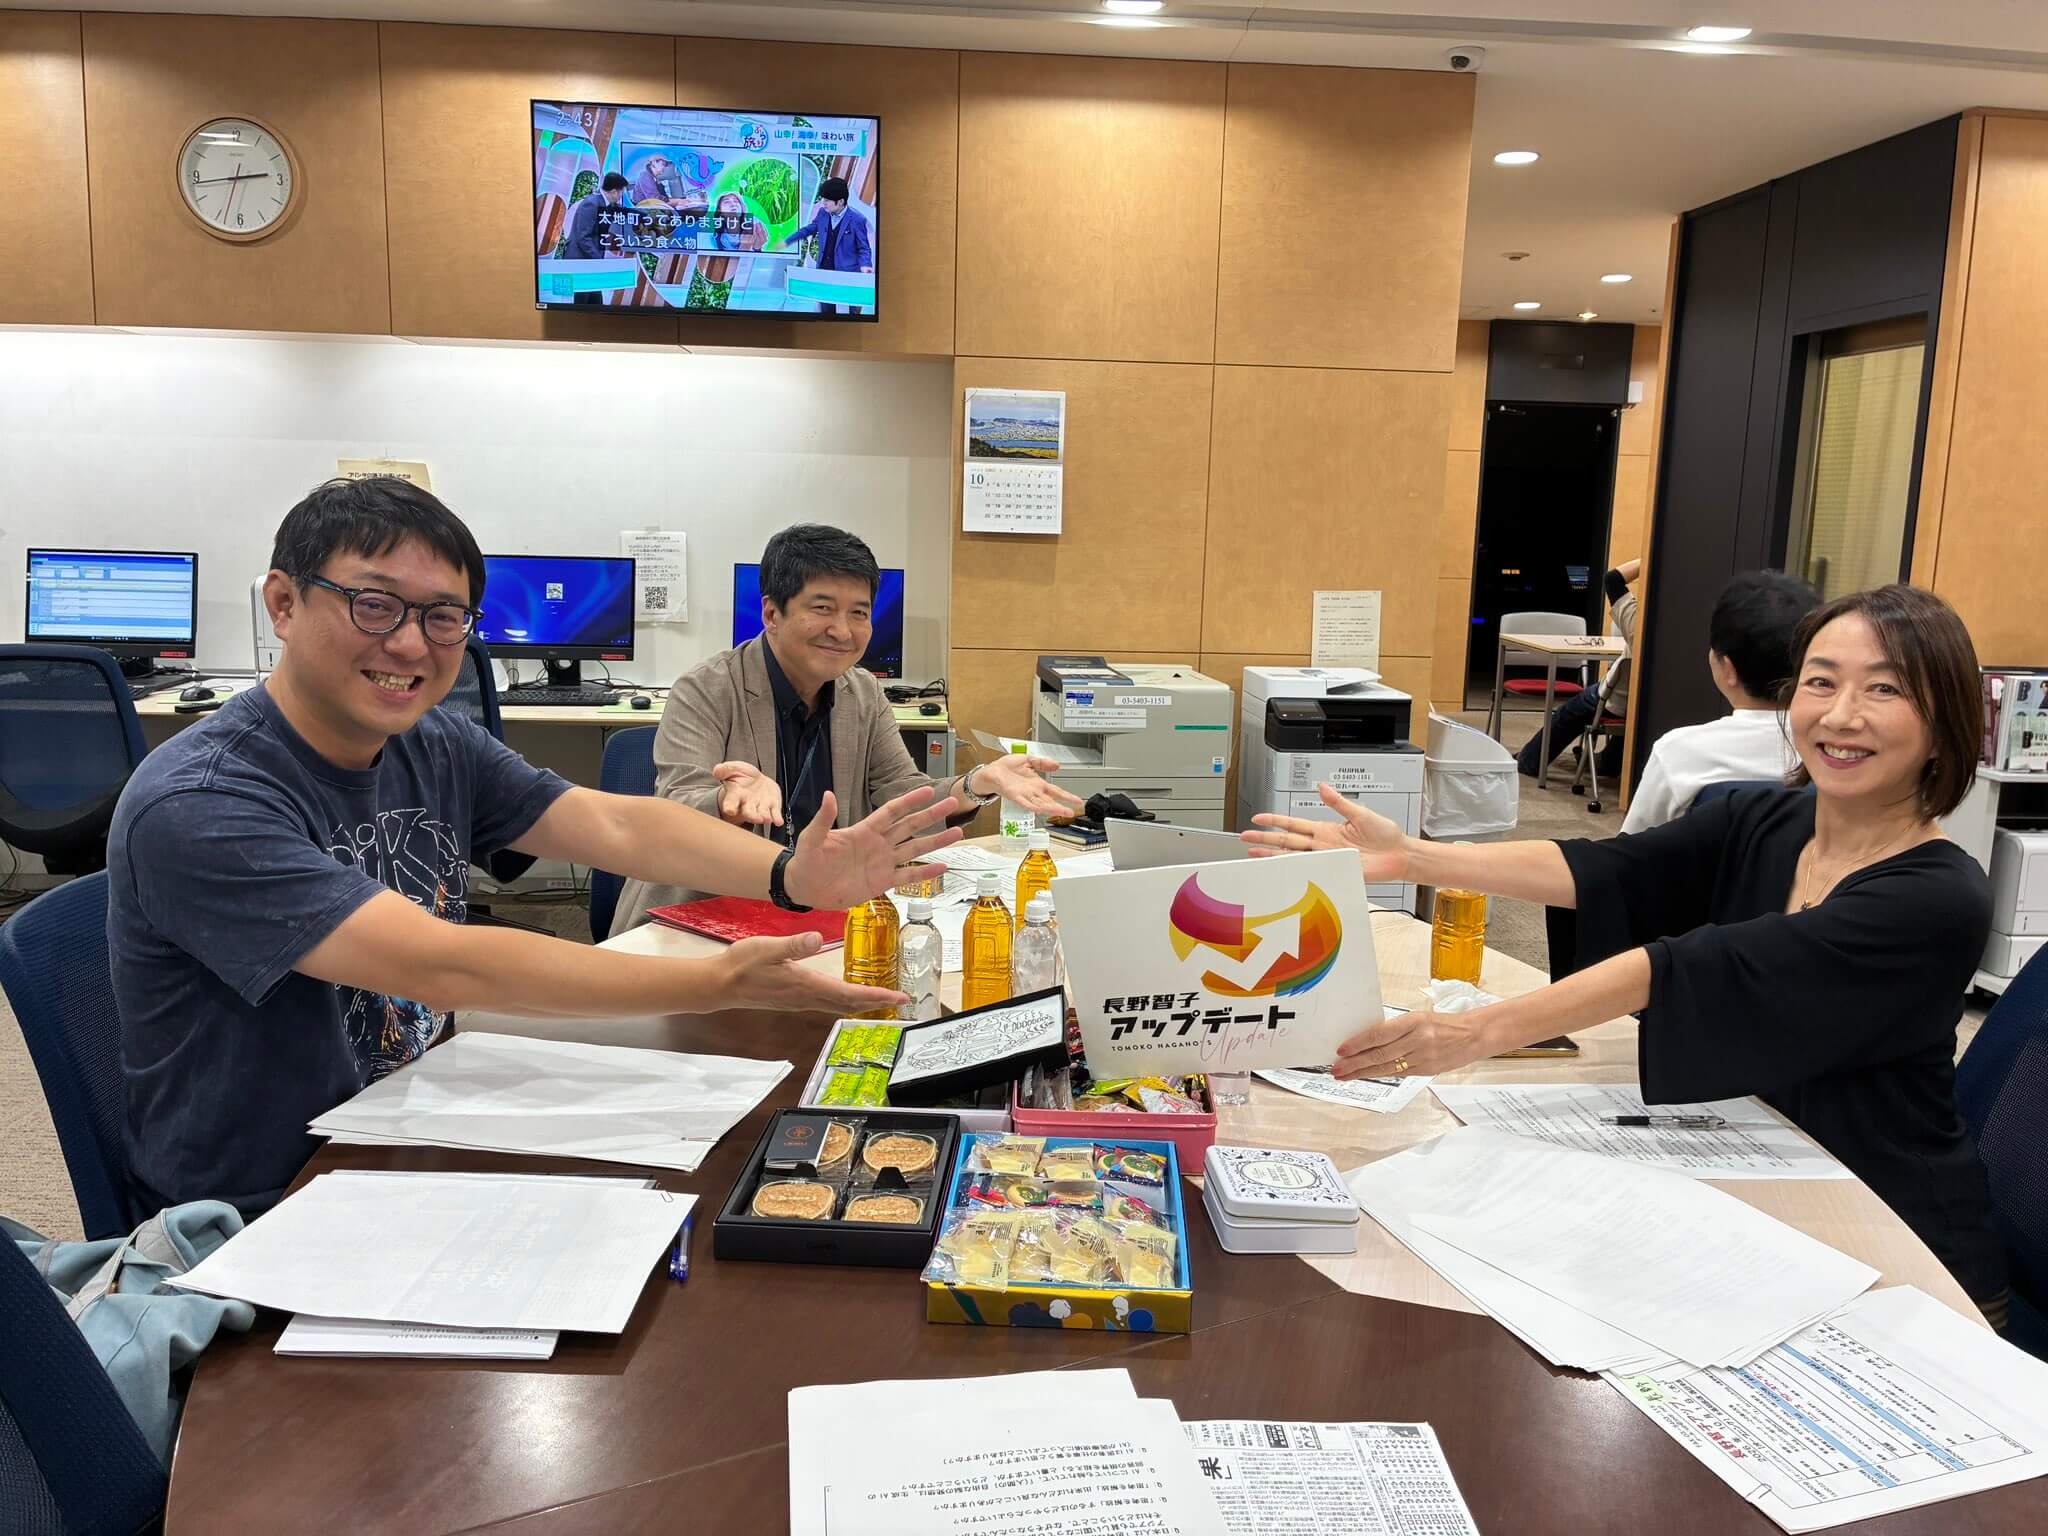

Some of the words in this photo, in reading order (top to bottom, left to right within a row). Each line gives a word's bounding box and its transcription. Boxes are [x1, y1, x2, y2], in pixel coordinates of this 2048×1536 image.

[276, 173, 284, 186] 3
[237, 213, 244, 226] 6
[598, 211, 753, 230] 太地町ってありますけど
[599, 233, 697, 249] こういう食べ物
[970, 473, 984, 485] 10
[1121, 697, 1165, 705] 03-5403-1151
[1103, 991, 1201, 1014] 長野智子
[1110, 1004, 1296, 1041] アップデート
[1111, 1043, 1153, 1052] TOMOKO
[1199, 1021, 1290, 1065] Update
[1668, 1396, 1749, 1459] 長野智子アップ
